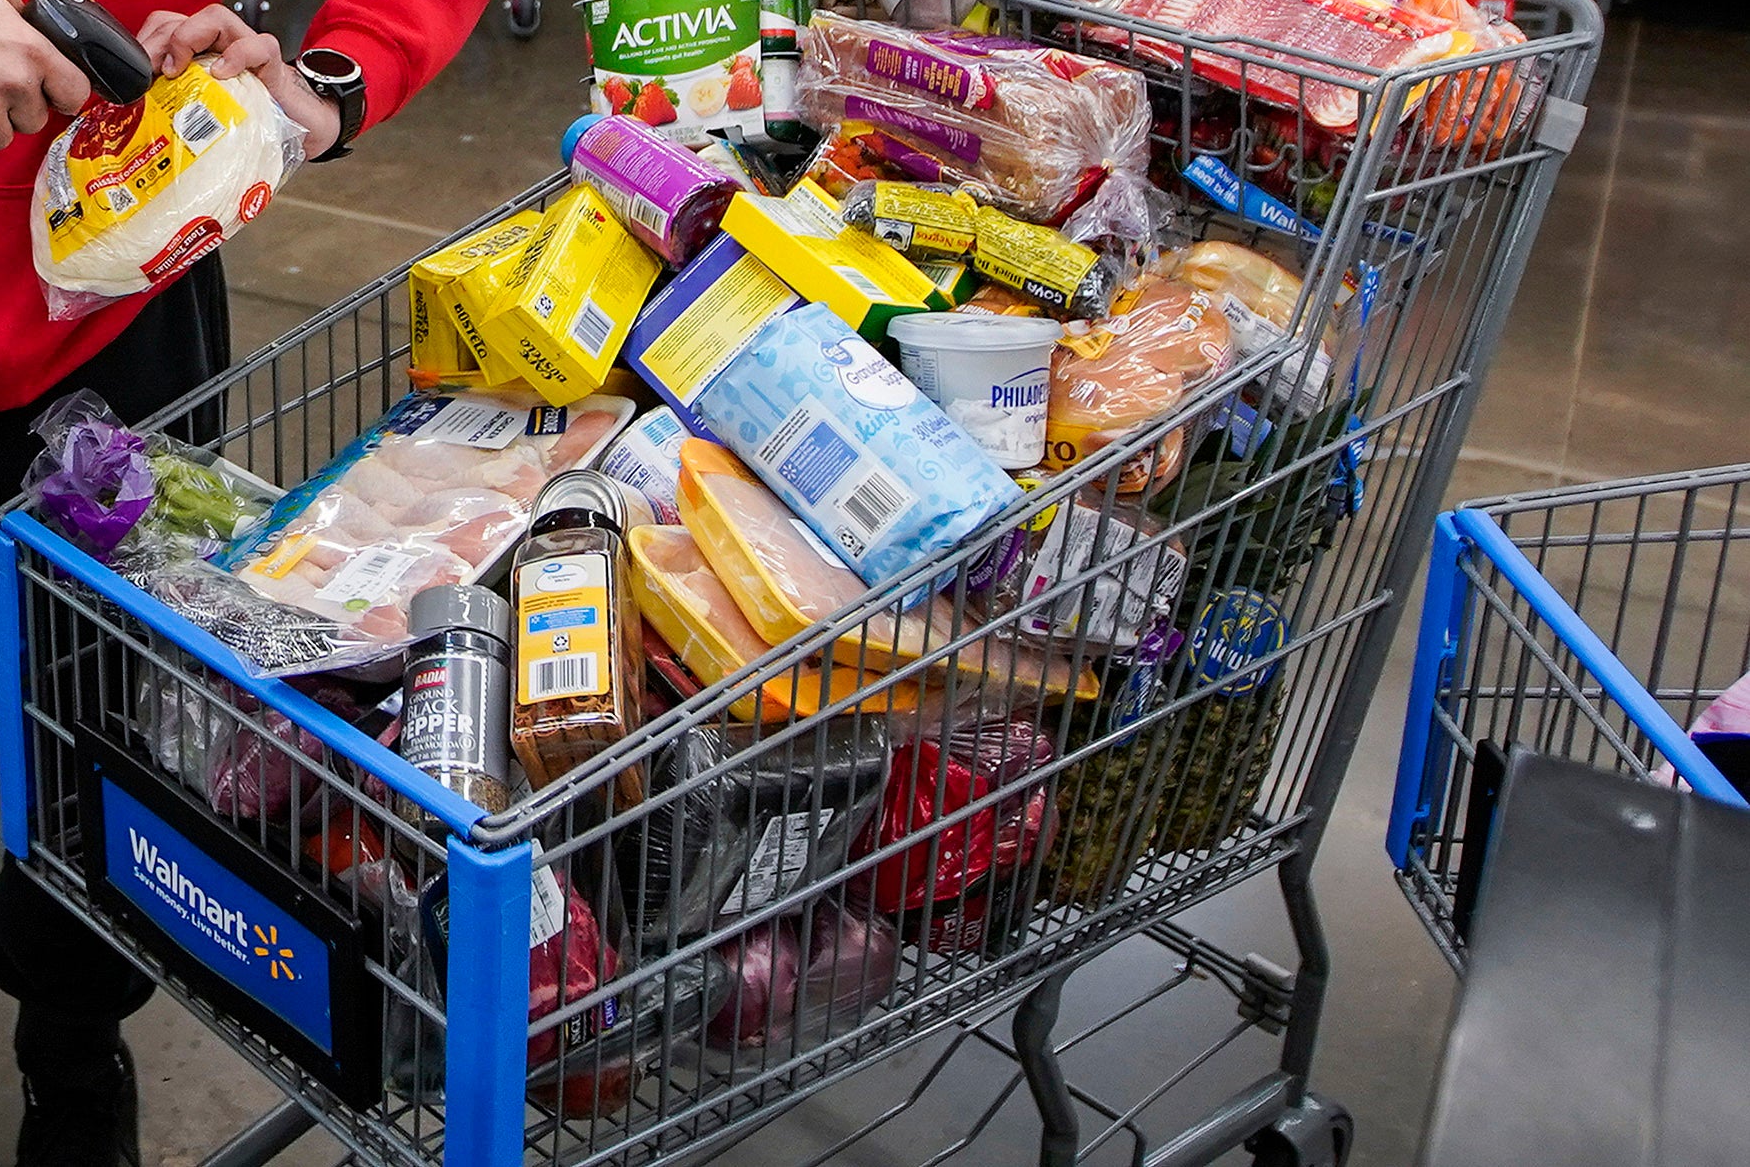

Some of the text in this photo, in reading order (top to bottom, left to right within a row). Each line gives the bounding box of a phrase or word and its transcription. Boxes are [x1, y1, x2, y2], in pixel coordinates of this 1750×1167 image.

[611, 6, 737, 52] ACTIVIA
[1024, 280, 1064, 304] GOYA
[414, 668, 448, 688] BADIA
[408, 687, 455, 706] GROUND
[406, 700, 461, 722] BLACK
[129, 827, 248, 948] Walmart
[134, 866, 251, 966] Save money. Live better.
